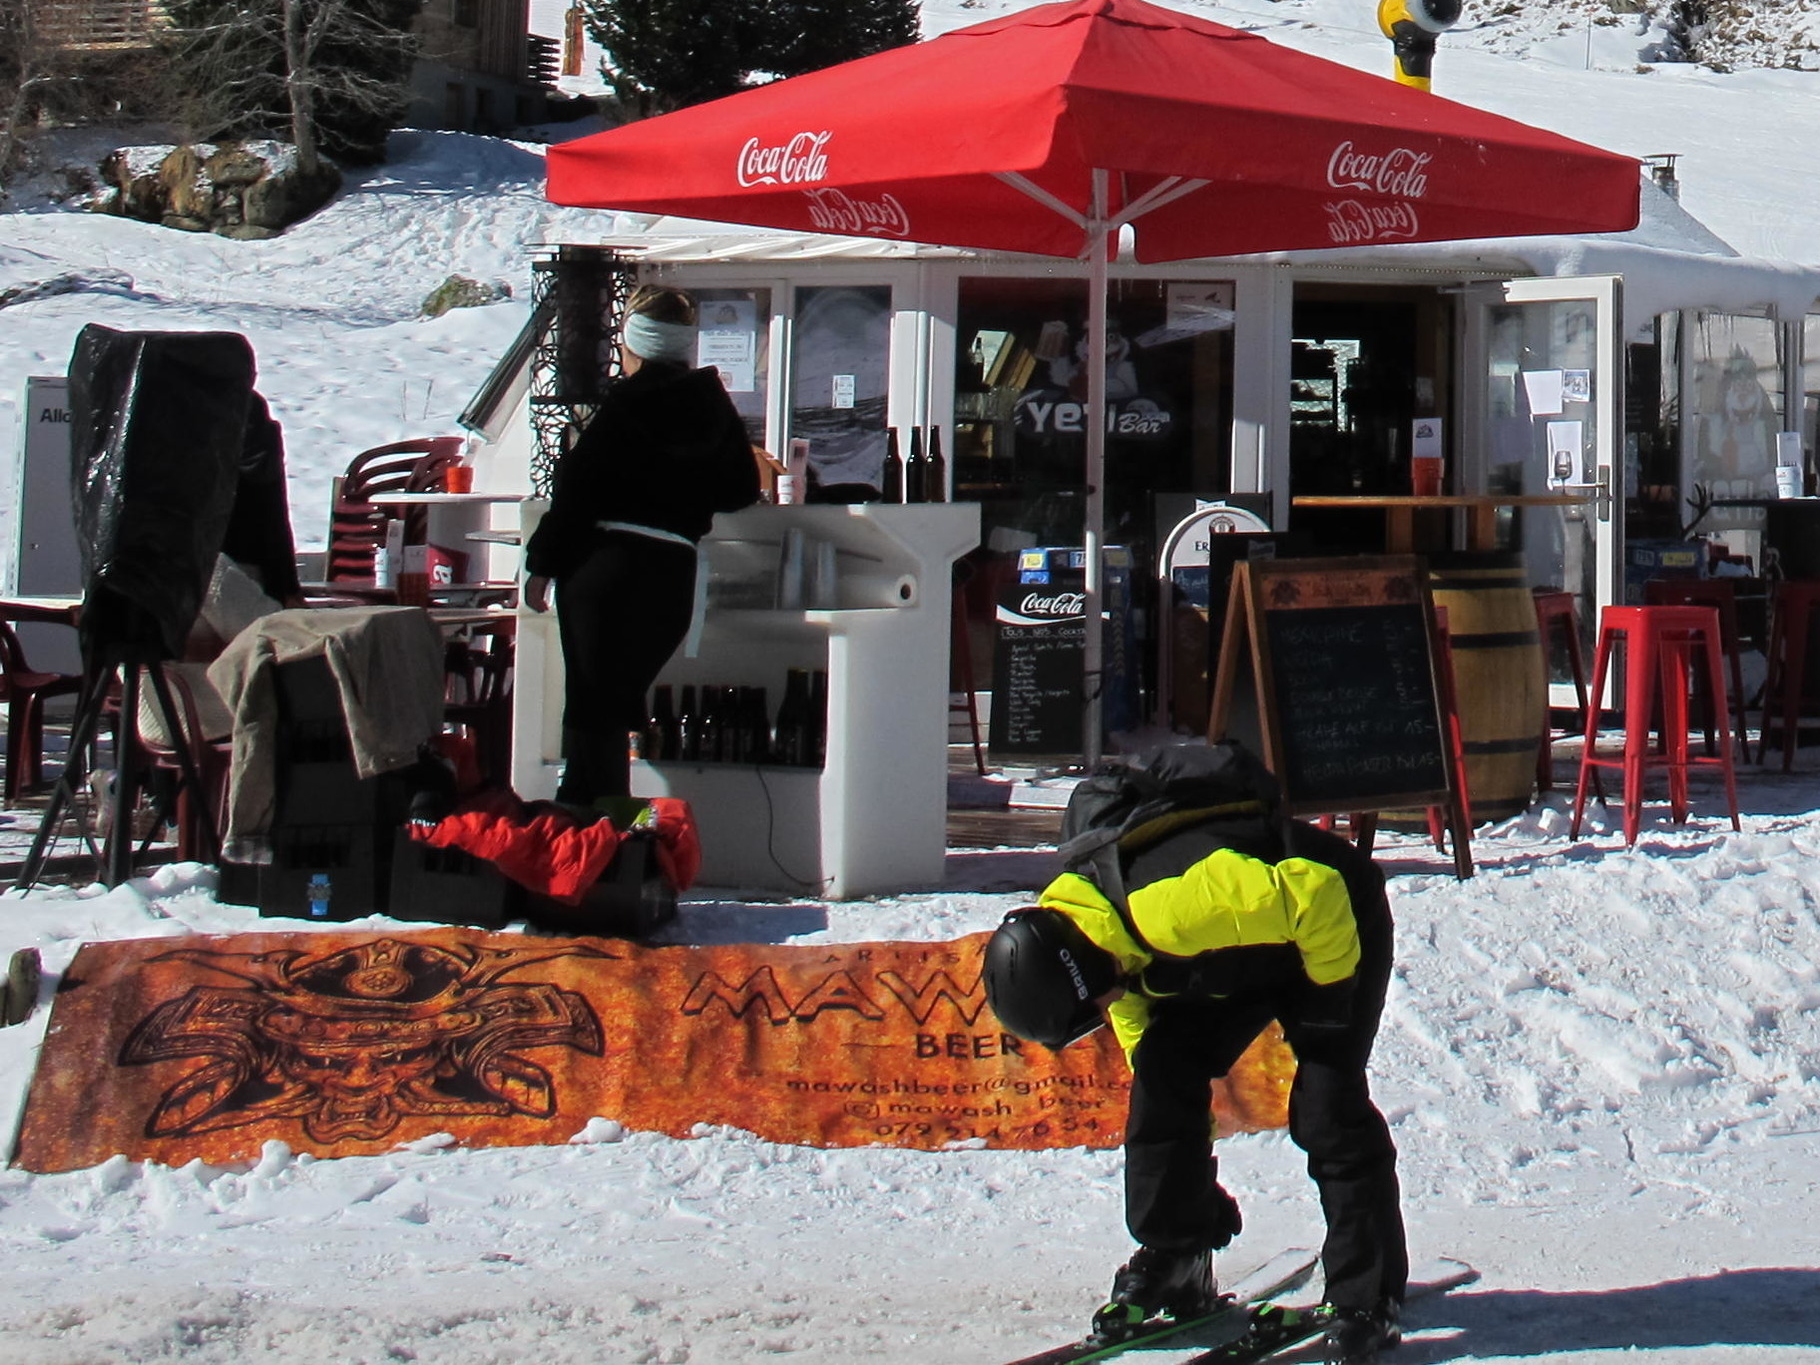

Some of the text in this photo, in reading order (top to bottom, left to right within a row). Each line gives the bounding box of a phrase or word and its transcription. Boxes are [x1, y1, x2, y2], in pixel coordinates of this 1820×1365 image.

[737, 130, 833, 187] Coca-Cola
[1327, 140, 1433, 197] Coca-Cola
[1118, 410, 1167, 434] Bar
[1020, 591, 1087, 615] Coca-Cola
[681, 965, 987, 1027] MAW
[915, 1033, 1026, 1059] BEER
[786, 1073, 1133, 1096] mawashbeer@gmail.co
[888, 1099, 1013, 1117] mawash
